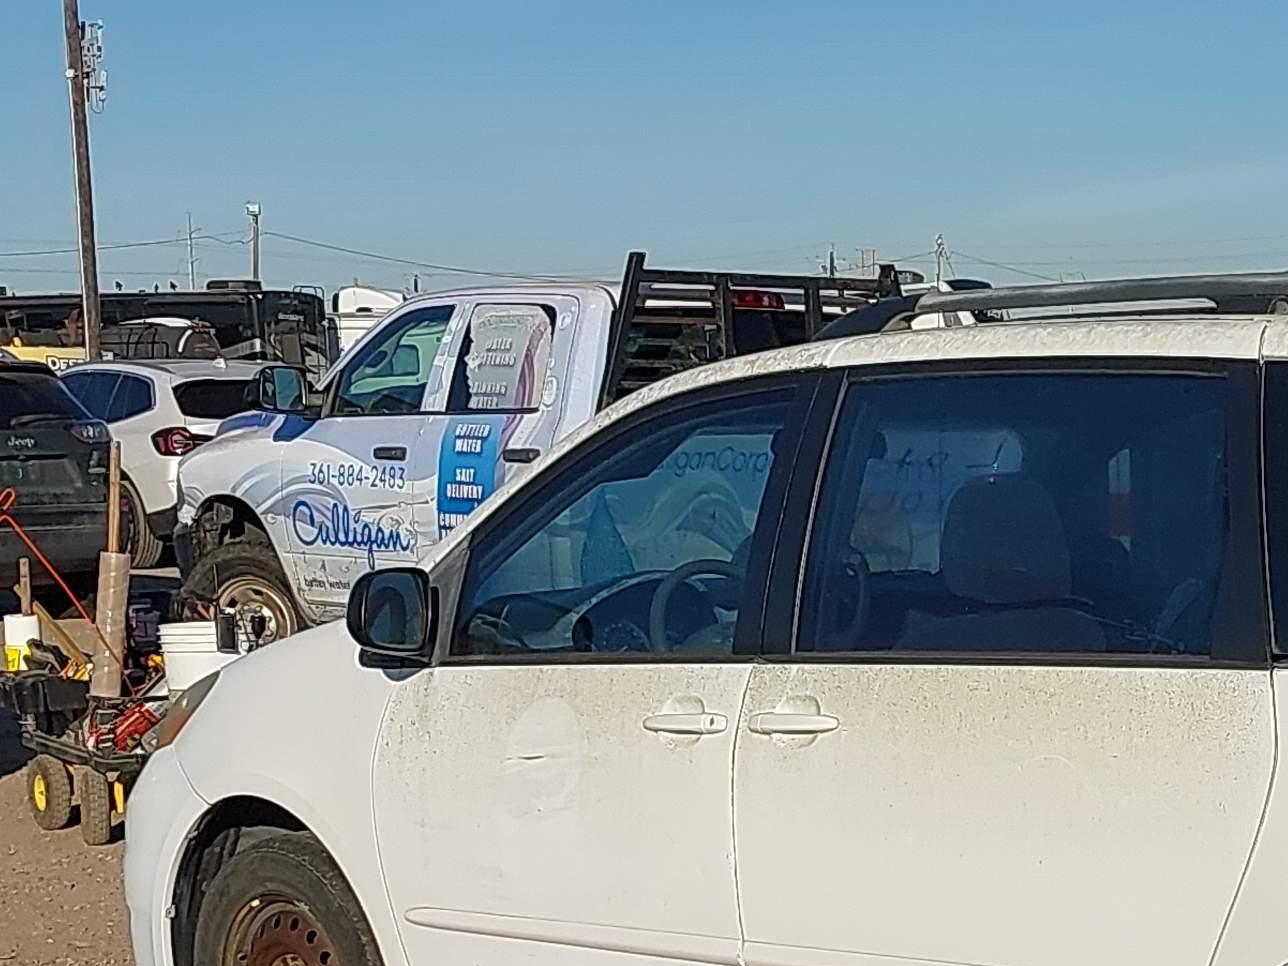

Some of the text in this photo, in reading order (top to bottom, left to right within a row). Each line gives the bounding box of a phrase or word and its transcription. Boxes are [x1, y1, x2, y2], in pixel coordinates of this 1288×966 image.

[455, 438, 482, 453] WATER
[308, 463, 405, 489] 361-884-2483
[455, 468, 475, 482] SALT
[446, 484, 483, 500] DELIVERY
[293, 500, 411, 570] Culligan
